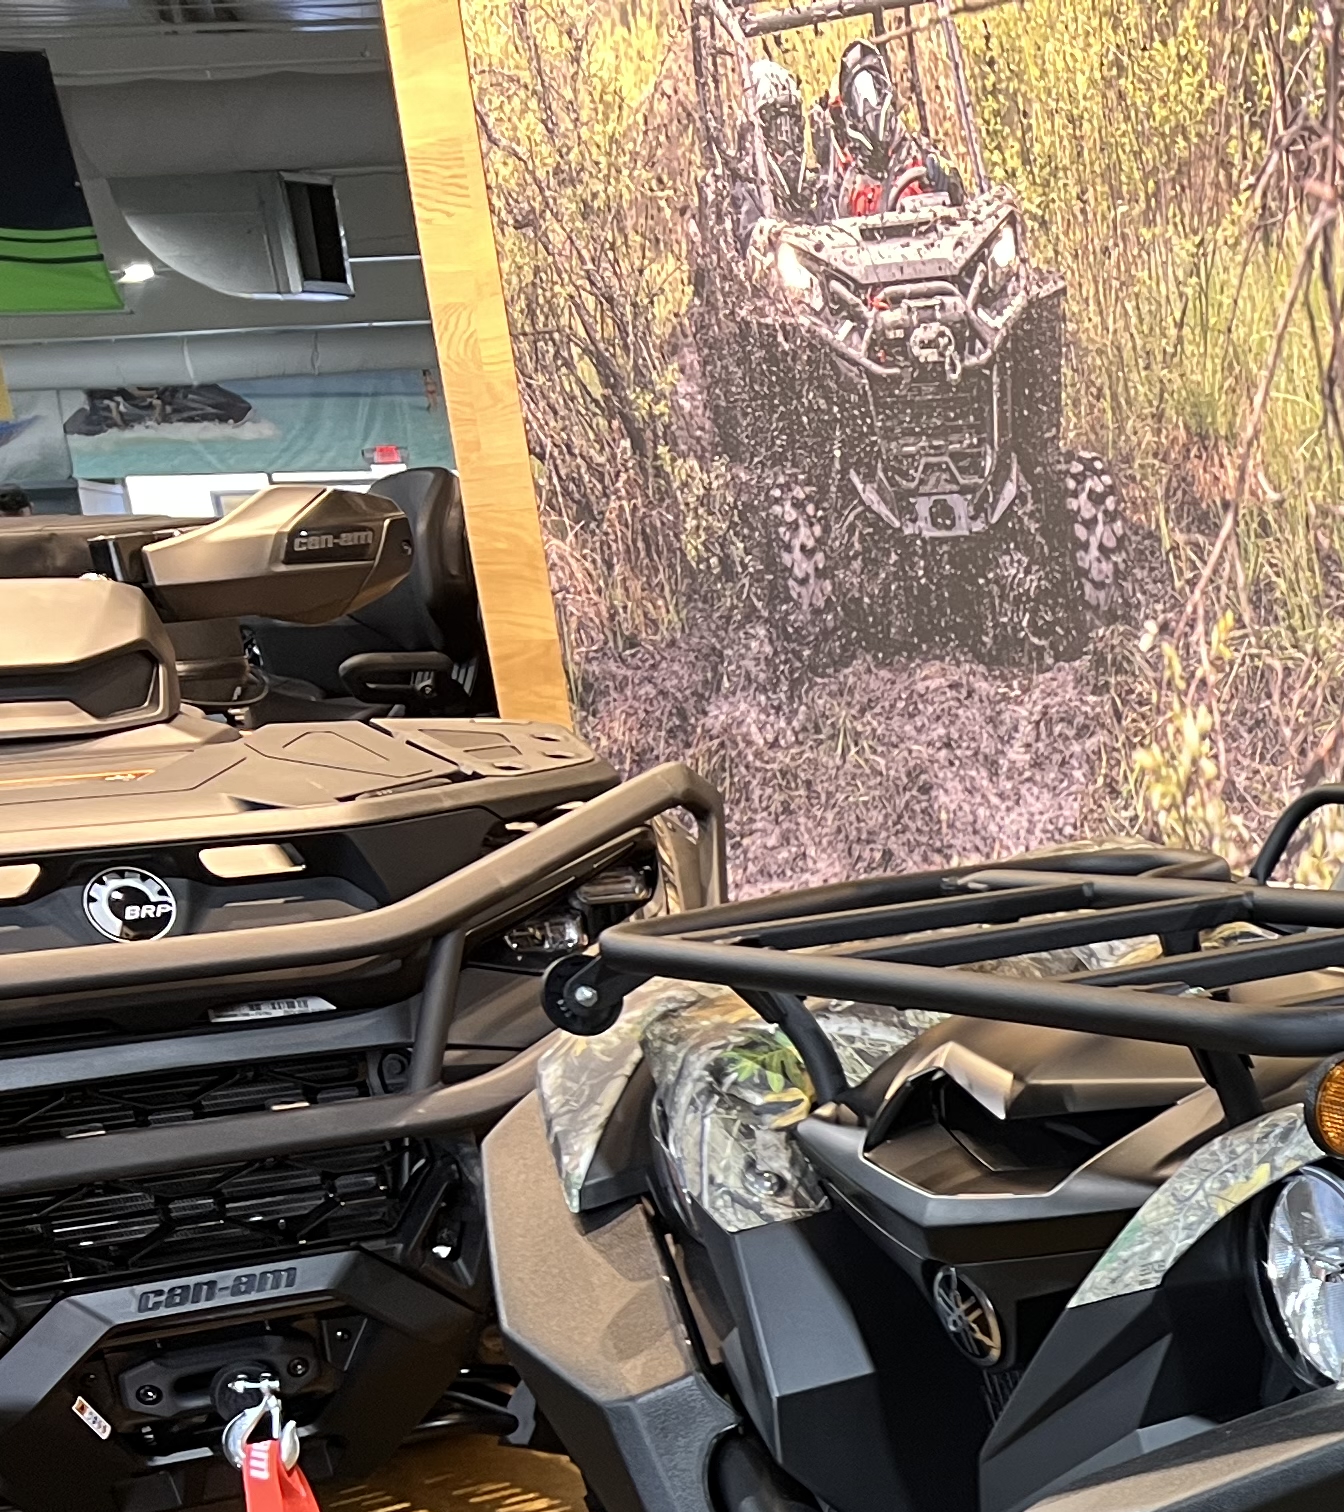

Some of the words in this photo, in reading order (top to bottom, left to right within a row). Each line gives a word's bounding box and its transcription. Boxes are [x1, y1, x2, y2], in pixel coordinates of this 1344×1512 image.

[293, 530, 374, 551] can-am
[124, 903, 173, 920] BRP
[137, 1266, 298, 1314] can-am
